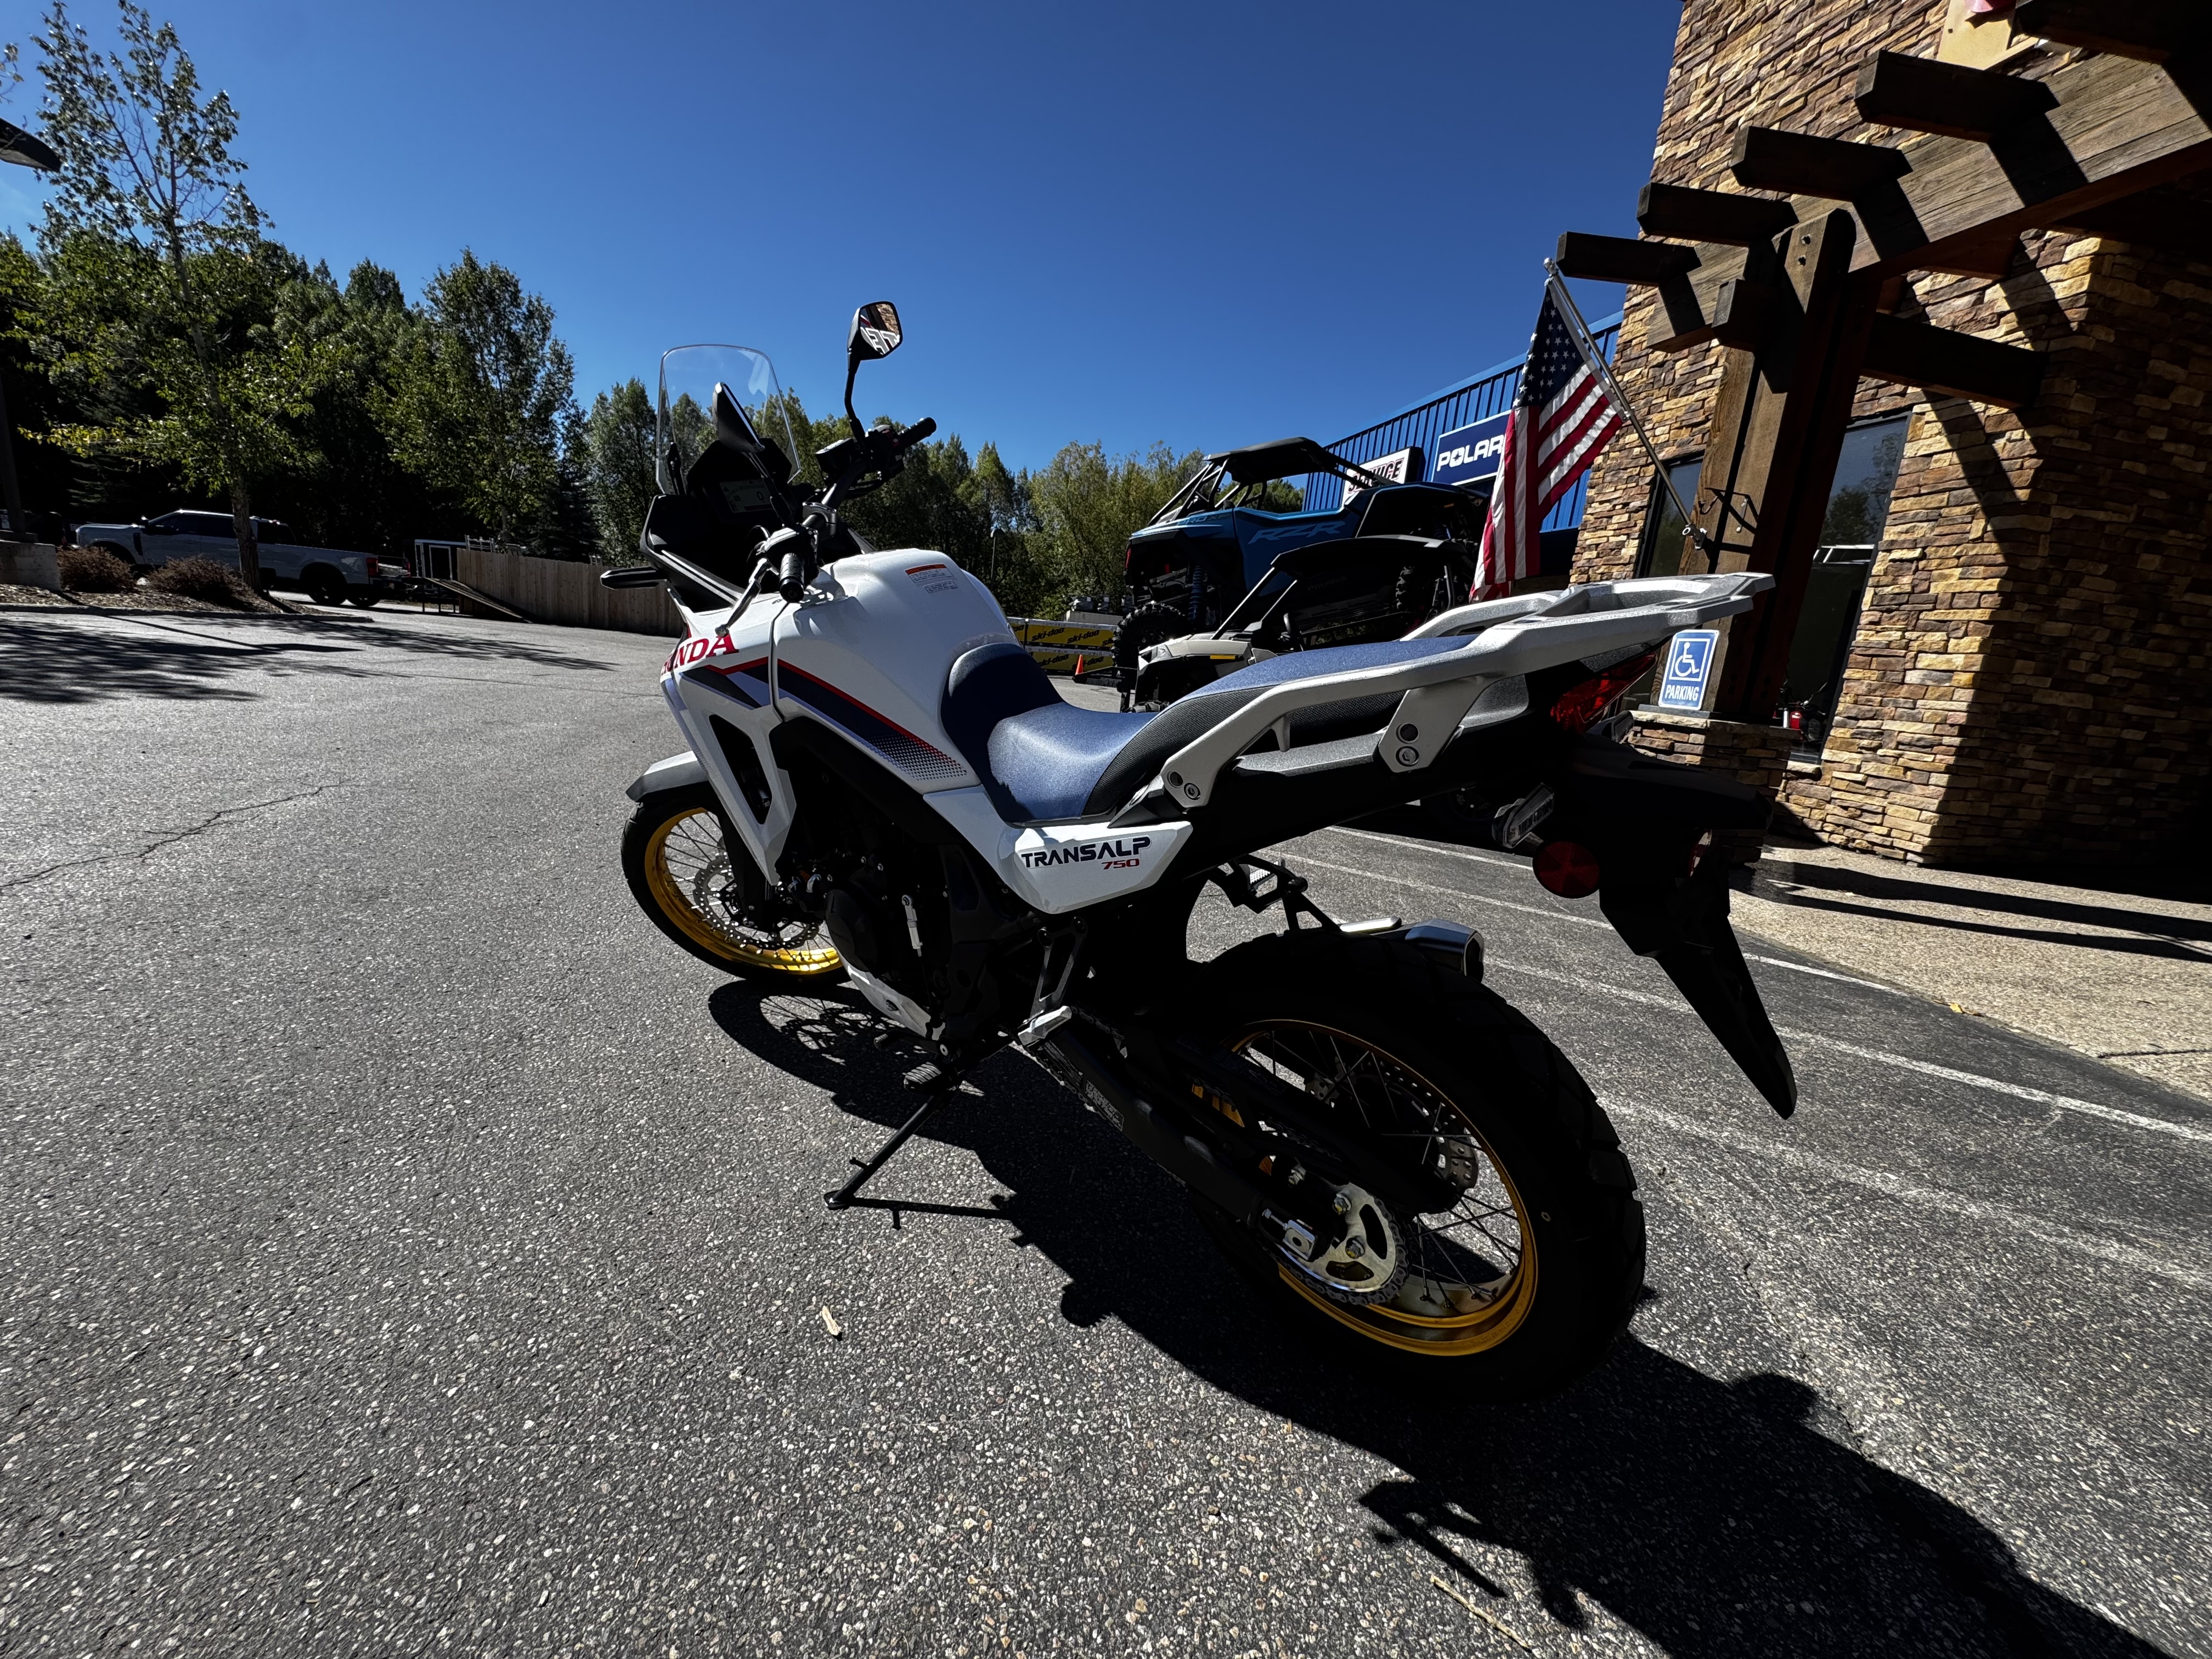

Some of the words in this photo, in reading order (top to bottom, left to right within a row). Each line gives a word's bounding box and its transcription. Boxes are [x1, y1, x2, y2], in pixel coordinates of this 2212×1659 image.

[1348, 457, 1404, 494] SVICE
[1247, 521, 1346, 545] RZR
[1071, 657, 1104, 670] si-doo
[1664, 684, 1700, 702] PARKING
[1021, 837, 1150, 868] TRANSALP
[1102, 858, 1140, 871] 750
